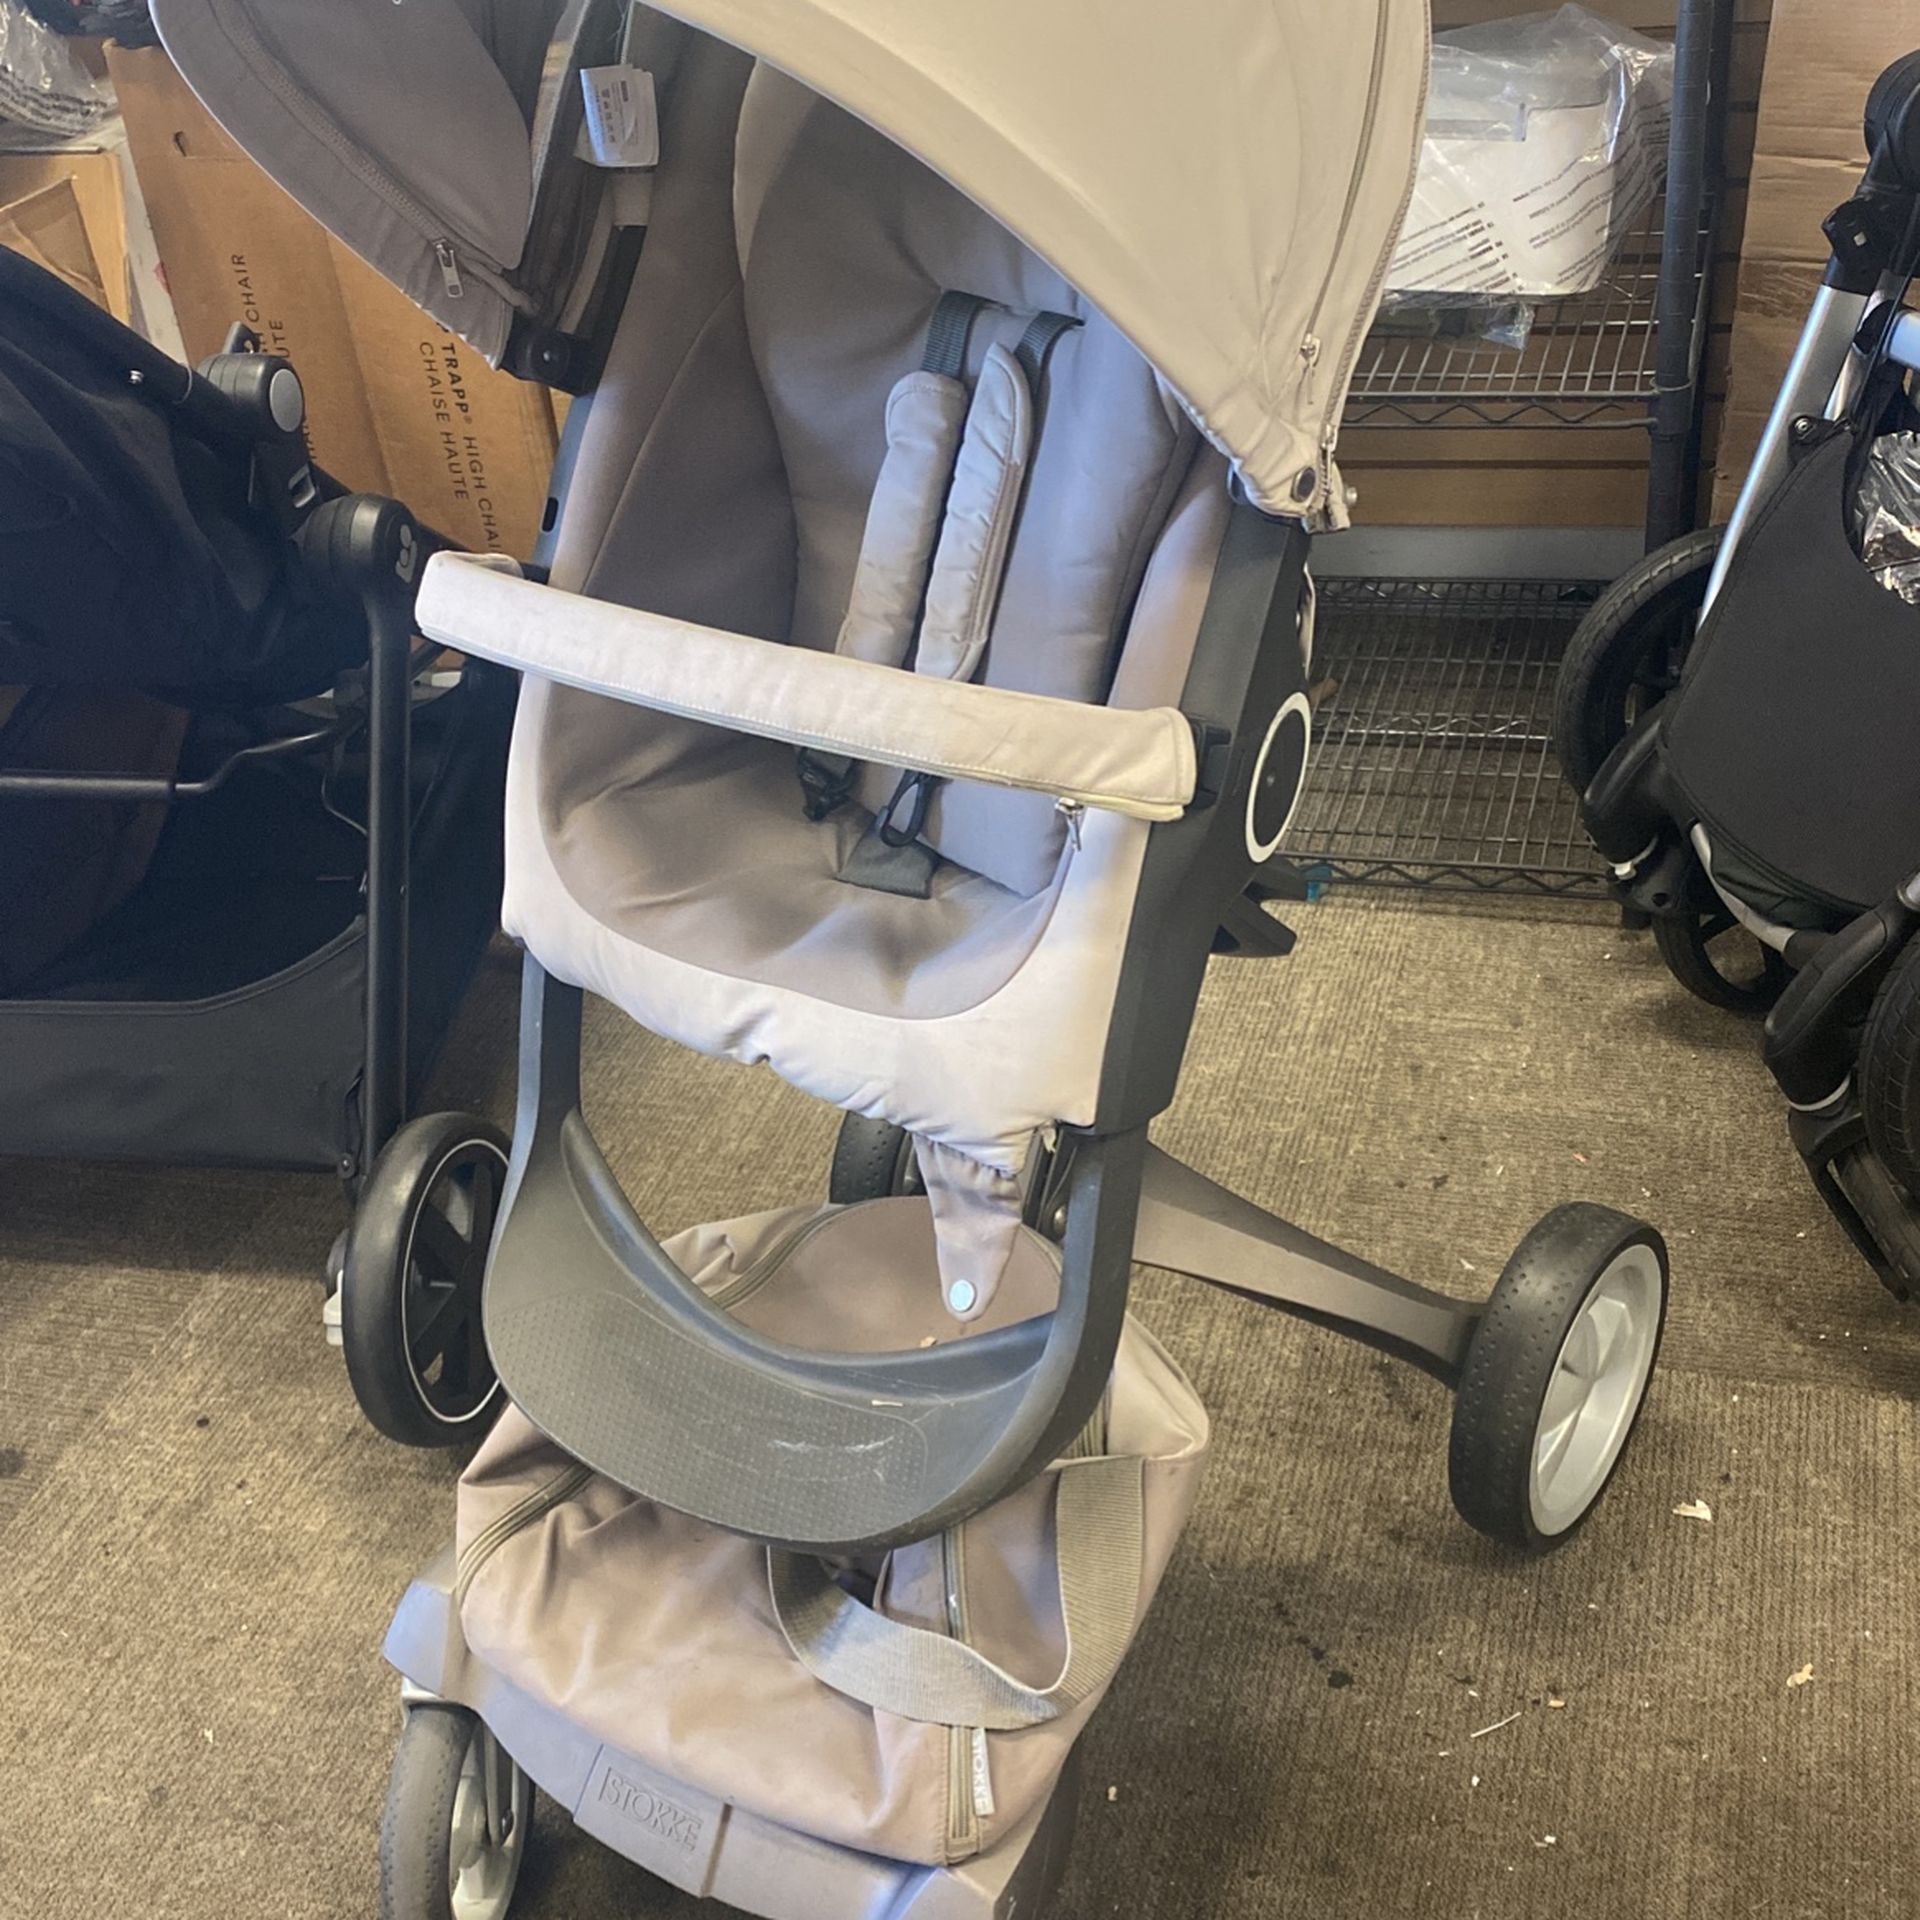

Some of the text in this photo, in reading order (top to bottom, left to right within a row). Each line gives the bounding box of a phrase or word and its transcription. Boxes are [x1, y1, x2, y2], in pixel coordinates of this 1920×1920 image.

[231, 253, 260, 323] CHAIR
[269, 319, 291, 359] UTE
[420, 342, 451, 422] CHAISE
[440, 431, 470, 500] HAUTE
[463, 436, 487, 489] HIGH
[478, 498, 505, 555] CHAI
[603, 1772, 702, 1852] STOKKE
